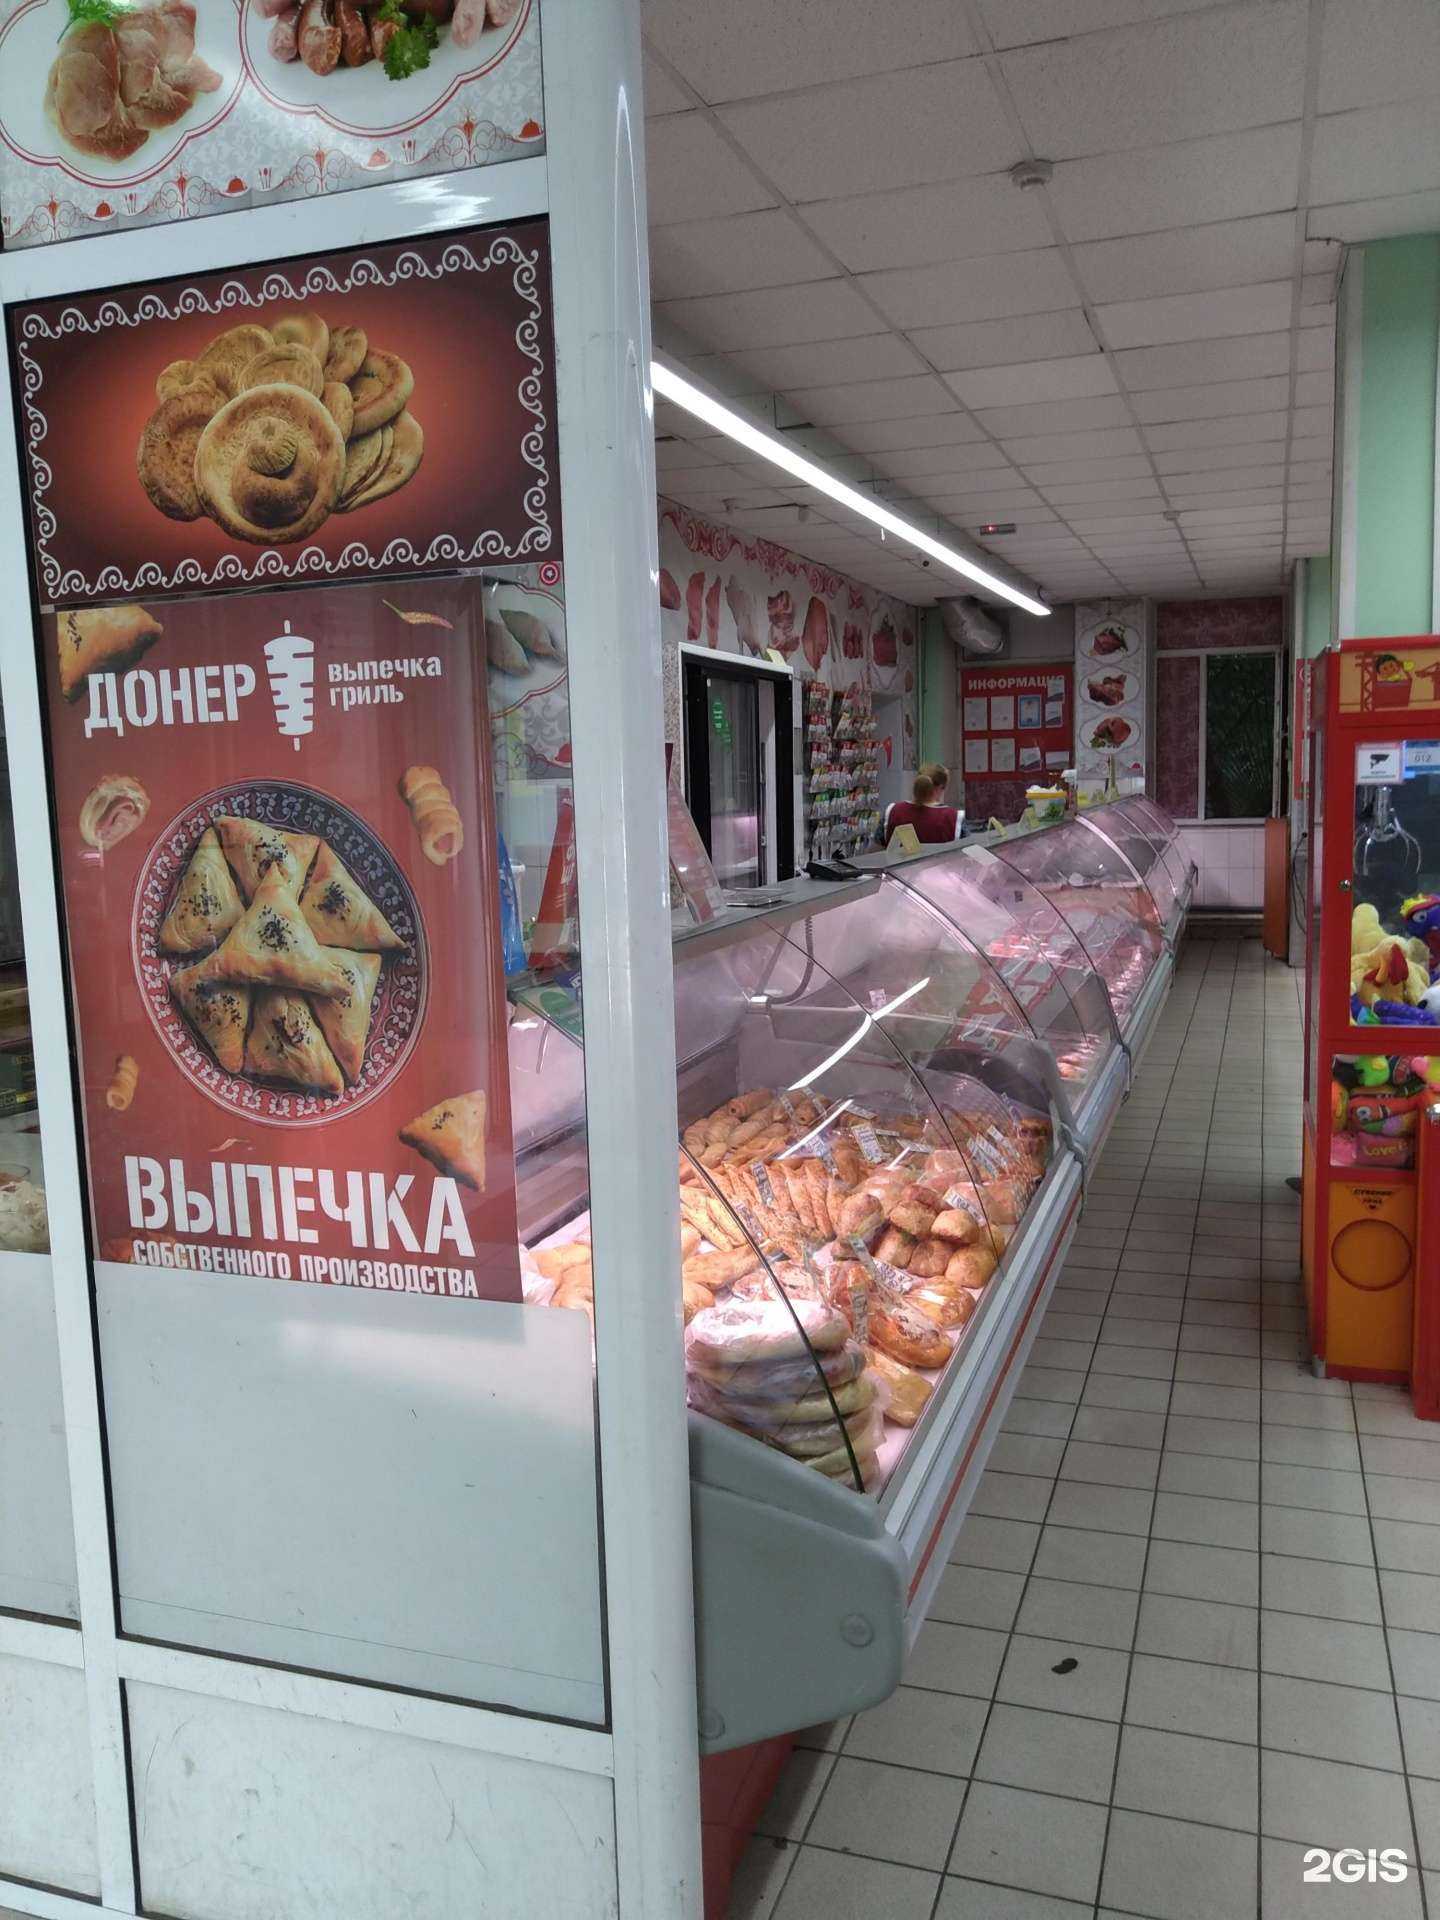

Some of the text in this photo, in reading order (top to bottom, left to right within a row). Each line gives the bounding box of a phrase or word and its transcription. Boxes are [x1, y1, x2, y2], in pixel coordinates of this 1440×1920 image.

[327, 656, 442, 682] выпечка
[968, 675, 1064, 690] ИНФОРМАЦ
[83, 664, 256, 738] ДОНЕР
[329, 684, 404, 711] гриль
[124, 1155, 476, 1257] ВЫПЕЧКА
[133, 1239, 479, 1297] СОБСТВЕННОГО ПРОИЗВОДСТВА
